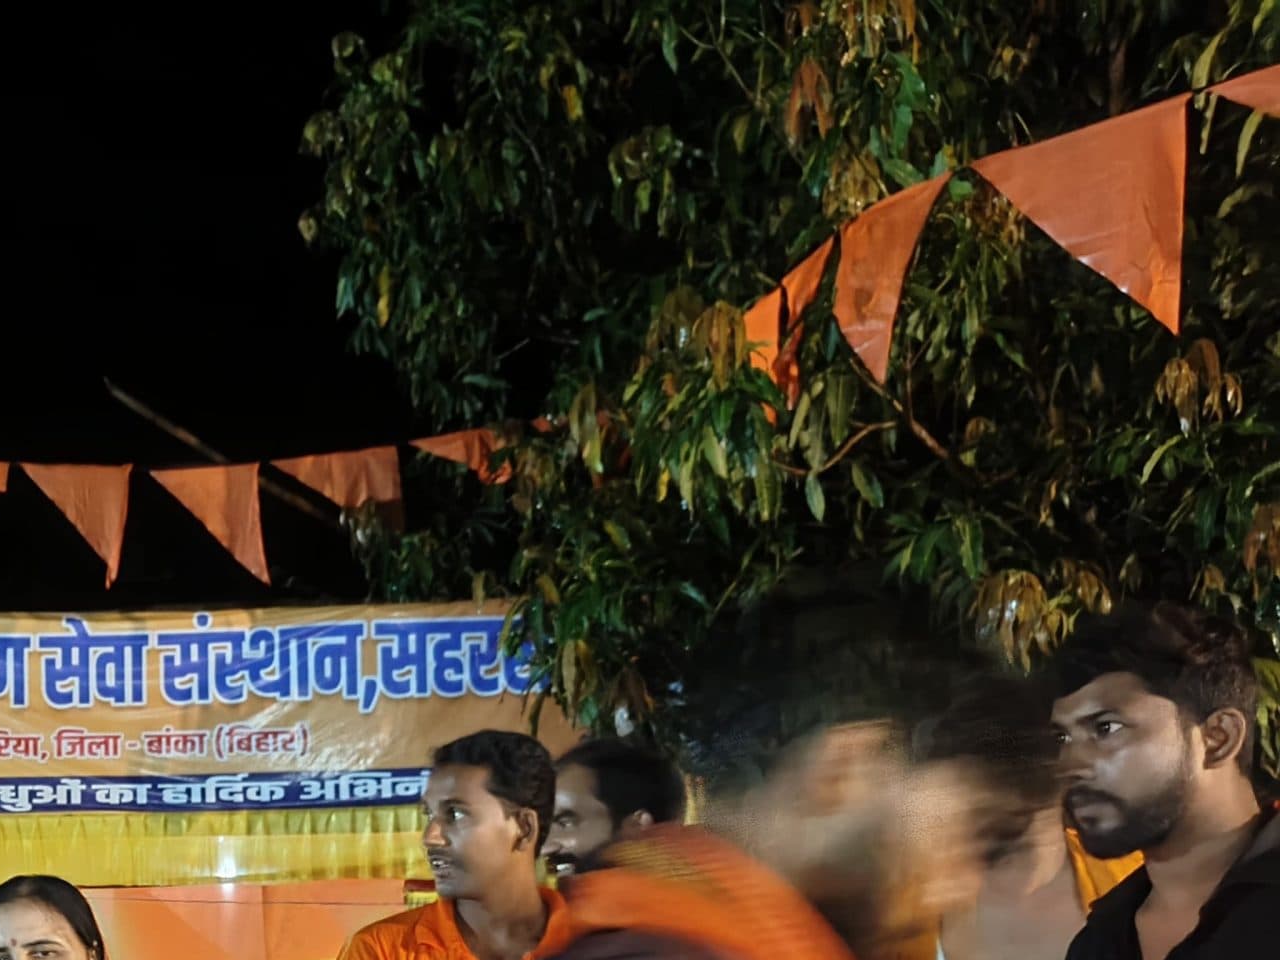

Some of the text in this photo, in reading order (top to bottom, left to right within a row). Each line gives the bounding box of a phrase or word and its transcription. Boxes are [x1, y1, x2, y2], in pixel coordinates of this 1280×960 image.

[37, 615, 151, 709] सेवा
[53, 728, 123, 758] जिला
[142, 727, 208, 758] बांका
[214, 722, 311, 759] (बिहार)
[90, 780, 152, 805] का
[156, 773, 291, 804] हार्दिक
